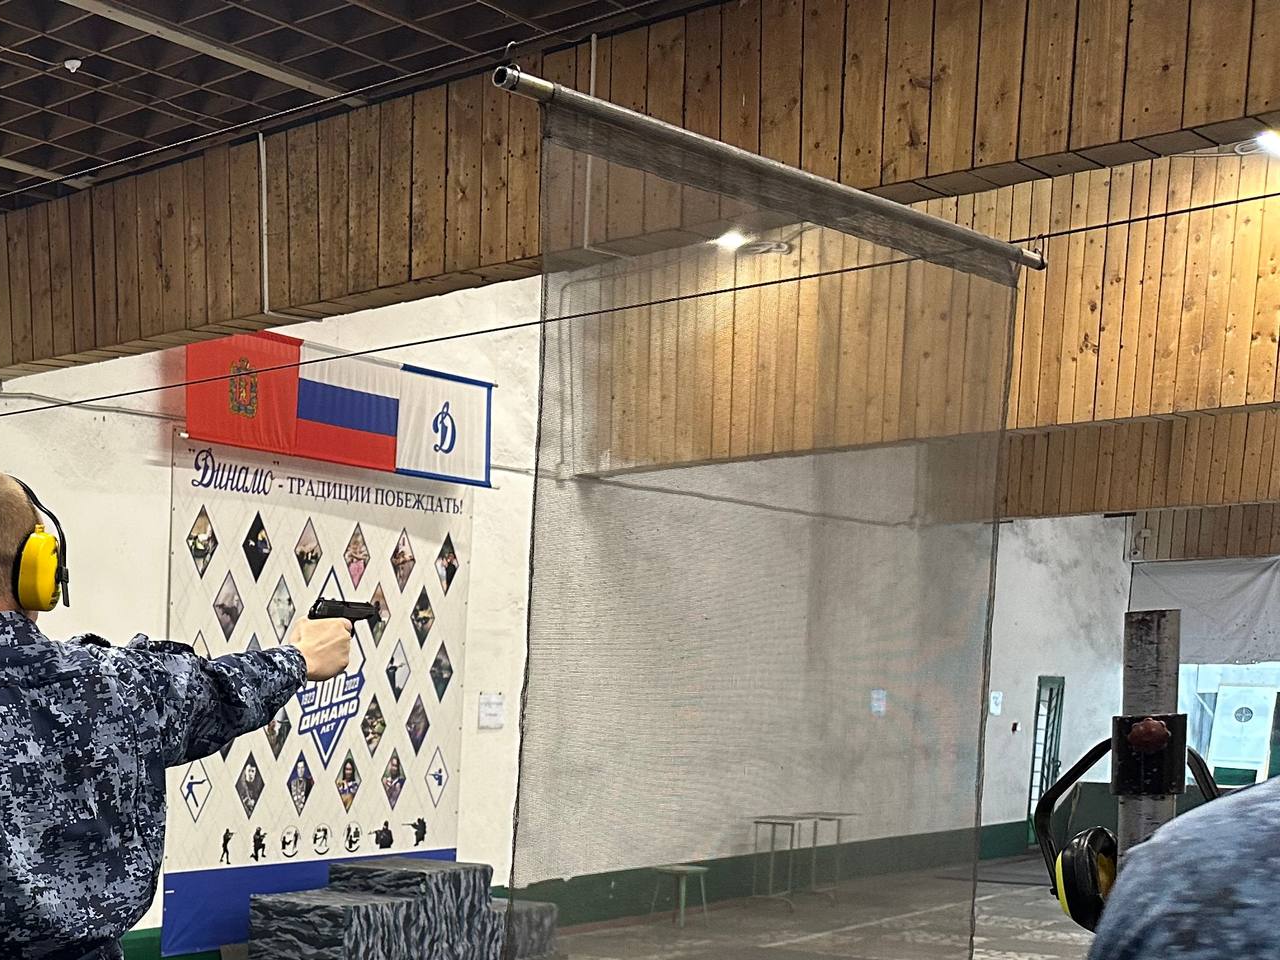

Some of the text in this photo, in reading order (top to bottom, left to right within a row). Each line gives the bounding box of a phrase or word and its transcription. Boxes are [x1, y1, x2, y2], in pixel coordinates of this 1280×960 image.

[287, 476, 370, 504] ТРАДИЦИИ
[375, 487, 463, 515] ПОБЕЖДАТЬ!
[300, 699, 359, 730] ДИНАМО
[320, 722, 336, 734] ЛЕТ
